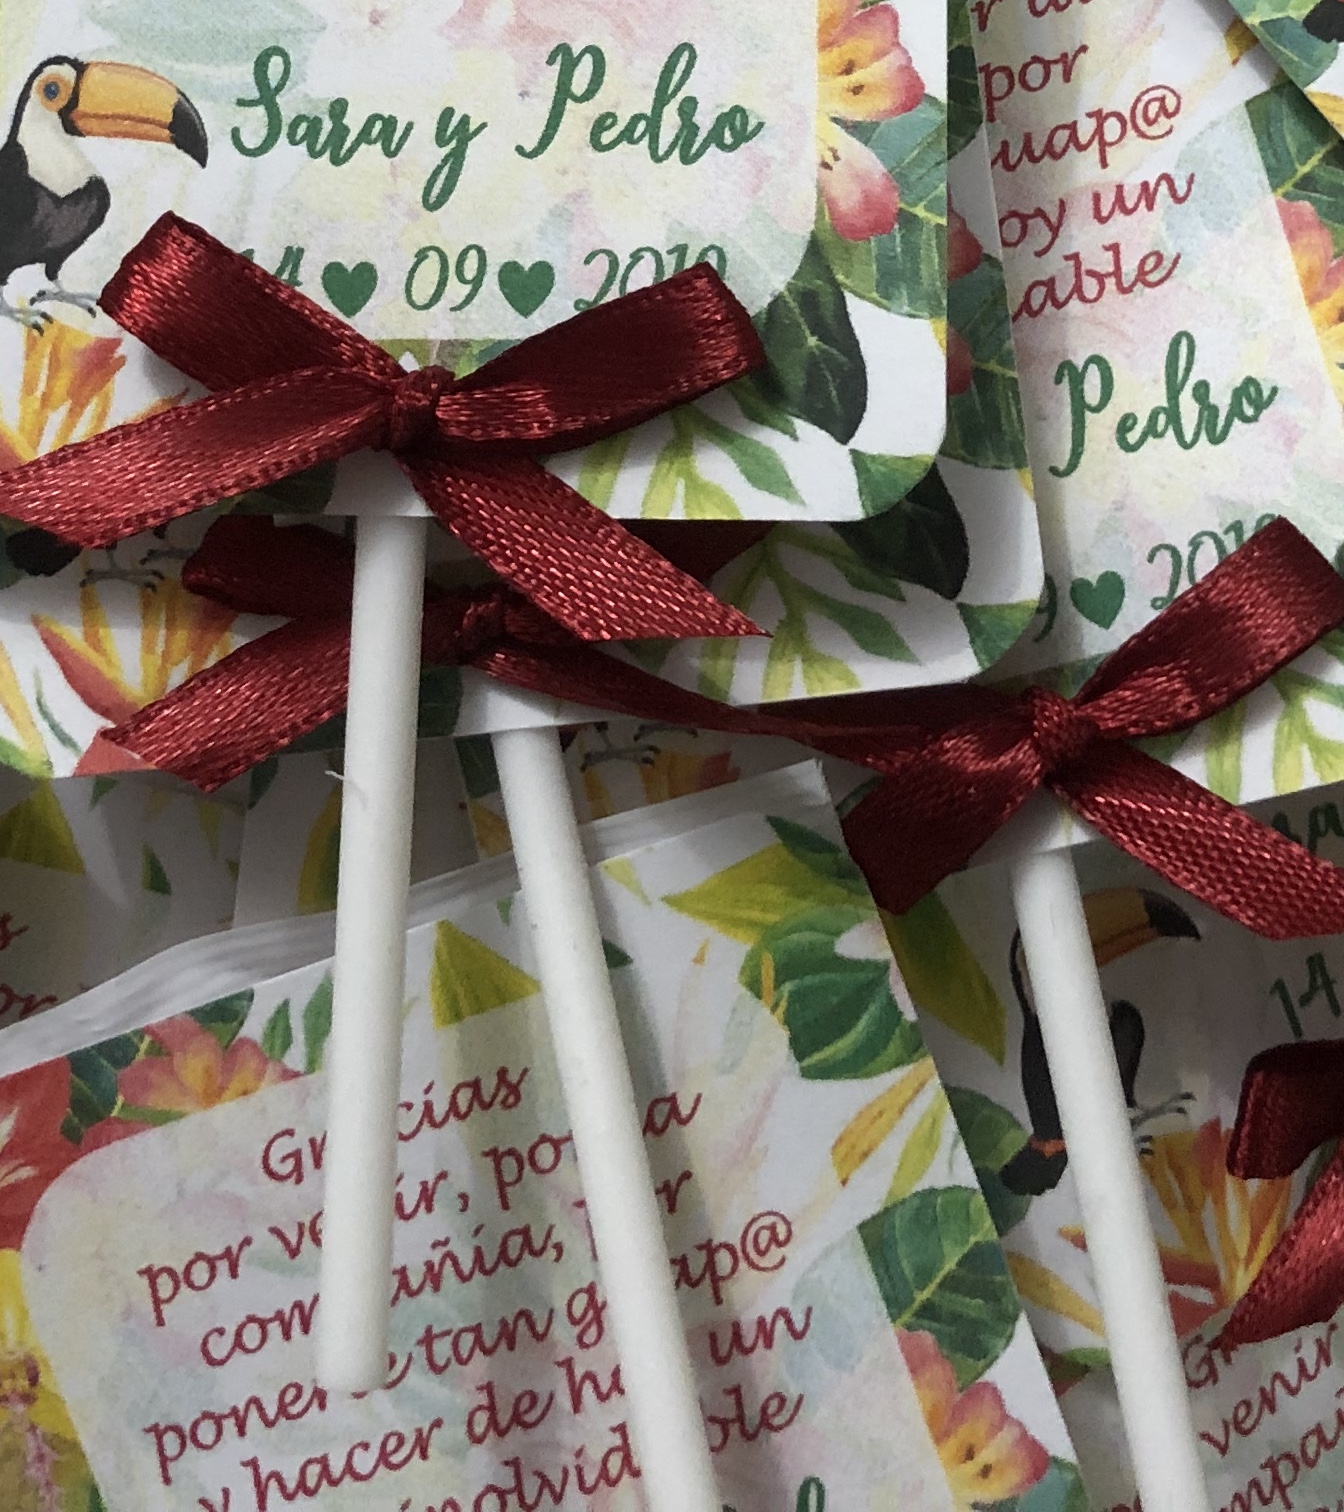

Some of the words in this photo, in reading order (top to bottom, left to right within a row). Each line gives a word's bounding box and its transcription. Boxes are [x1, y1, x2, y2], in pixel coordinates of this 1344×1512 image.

[979, 44, 1089, 123] por
[231, 45, 412, 166] Sara
[423, 109, 482, 213] y
[517, 45, 763, 165] Pedro
[1092, 173, 1194, 225] un
[406, 245, 487, 309] 09
[1048, 330, 1278, 477] Pedro
[1268, 951, 1342, 1038] 14
[137, 1235, 253, 1327] por
[417, 1309, 552, 1374] tan
